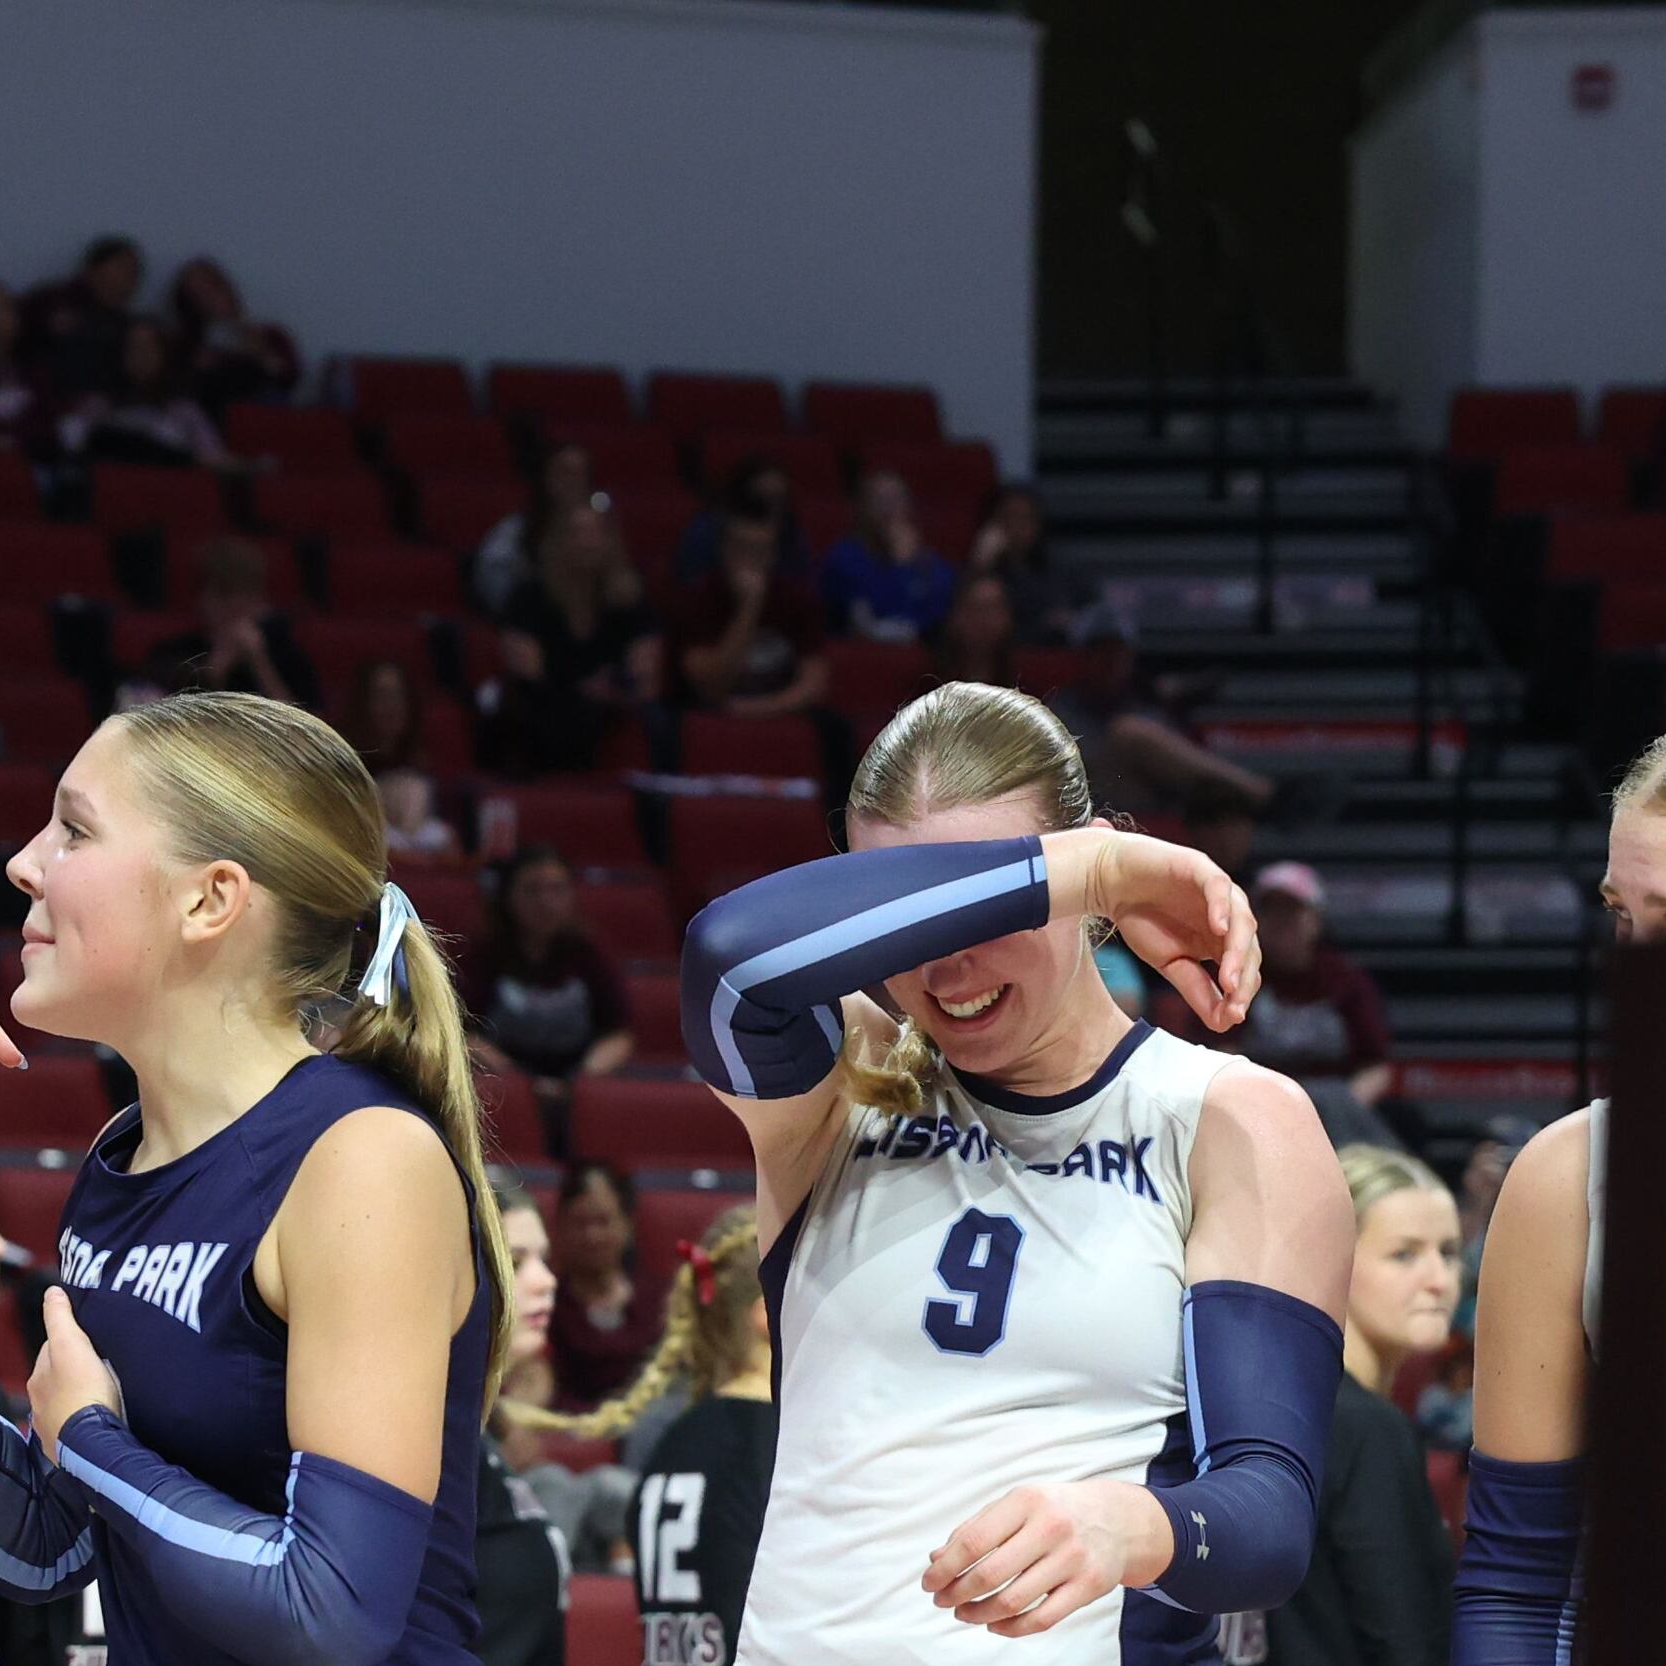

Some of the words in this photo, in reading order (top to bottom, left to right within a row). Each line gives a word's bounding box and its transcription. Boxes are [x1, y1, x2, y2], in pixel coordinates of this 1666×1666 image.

[110, 1241, 230, 1334] PARK
[921, 1206, 1026, 1357] 9
[638, 1471, 707, 1602] 12
